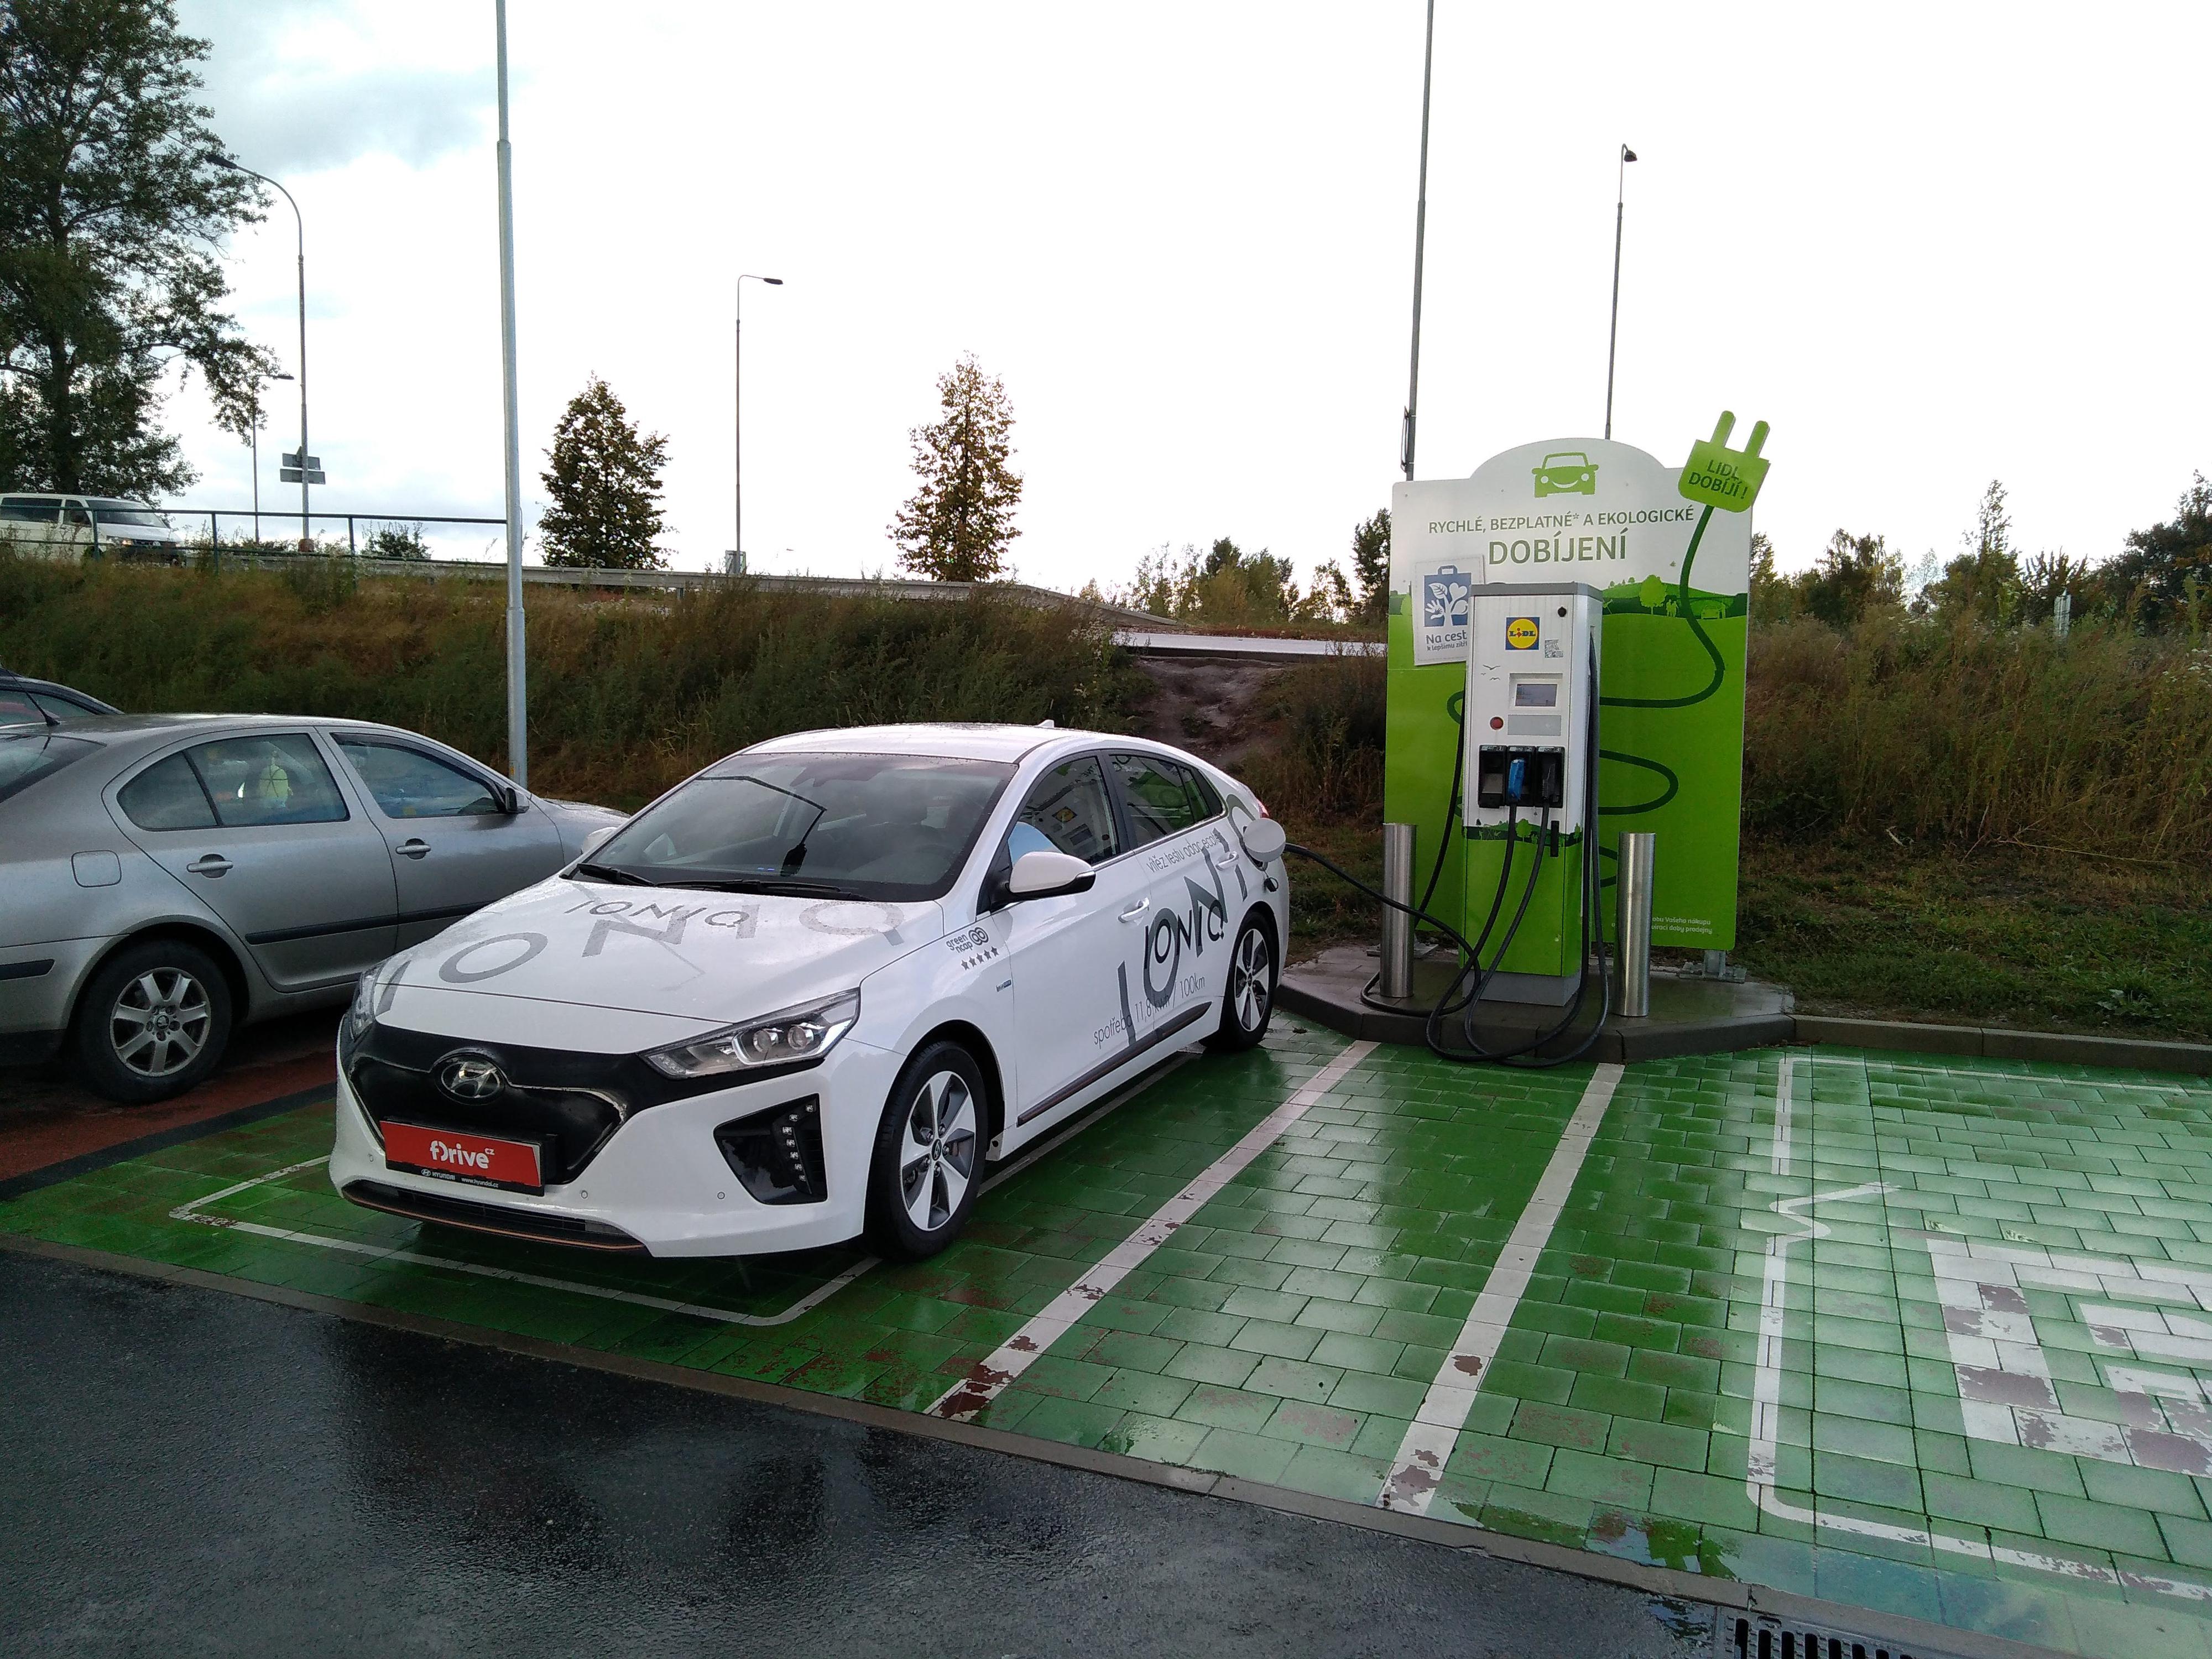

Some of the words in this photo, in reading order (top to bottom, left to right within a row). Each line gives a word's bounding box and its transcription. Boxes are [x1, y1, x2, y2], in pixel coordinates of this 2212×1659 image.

[1707, 460, 1740, 480] LIDL
[1428, 515, 1486, 534] RYCHLÉ,
[1583, 513, 1594, 526] A
[1598, 504, 1694, 525] EKOLOGICKÉ
[1489, 526, 1629, 565] DOBÍJENÍ
[1426, 634, 1442, 644] Na
[1444, 629, 1468, 642] cest
[1164, 848, 1185, 865] testu
[1183, 838, 1203, 858] adac
[564, 899, 750, 928] IONIQ
[946, 934, 969, 951] green
[955, 941, 973, 953] ncap
[1144, 899, 1224, 969] IONIQ
[1093, 1010, 1133, 1049] spotřeba
[1135, 998, 1152, 1022] 11,8
[1180, 972, 1205, 999] 100km
[432, 1171, 456, 1181] HYUNDAI
[461, 1177, 499, 1188] www.hyundai.cz
